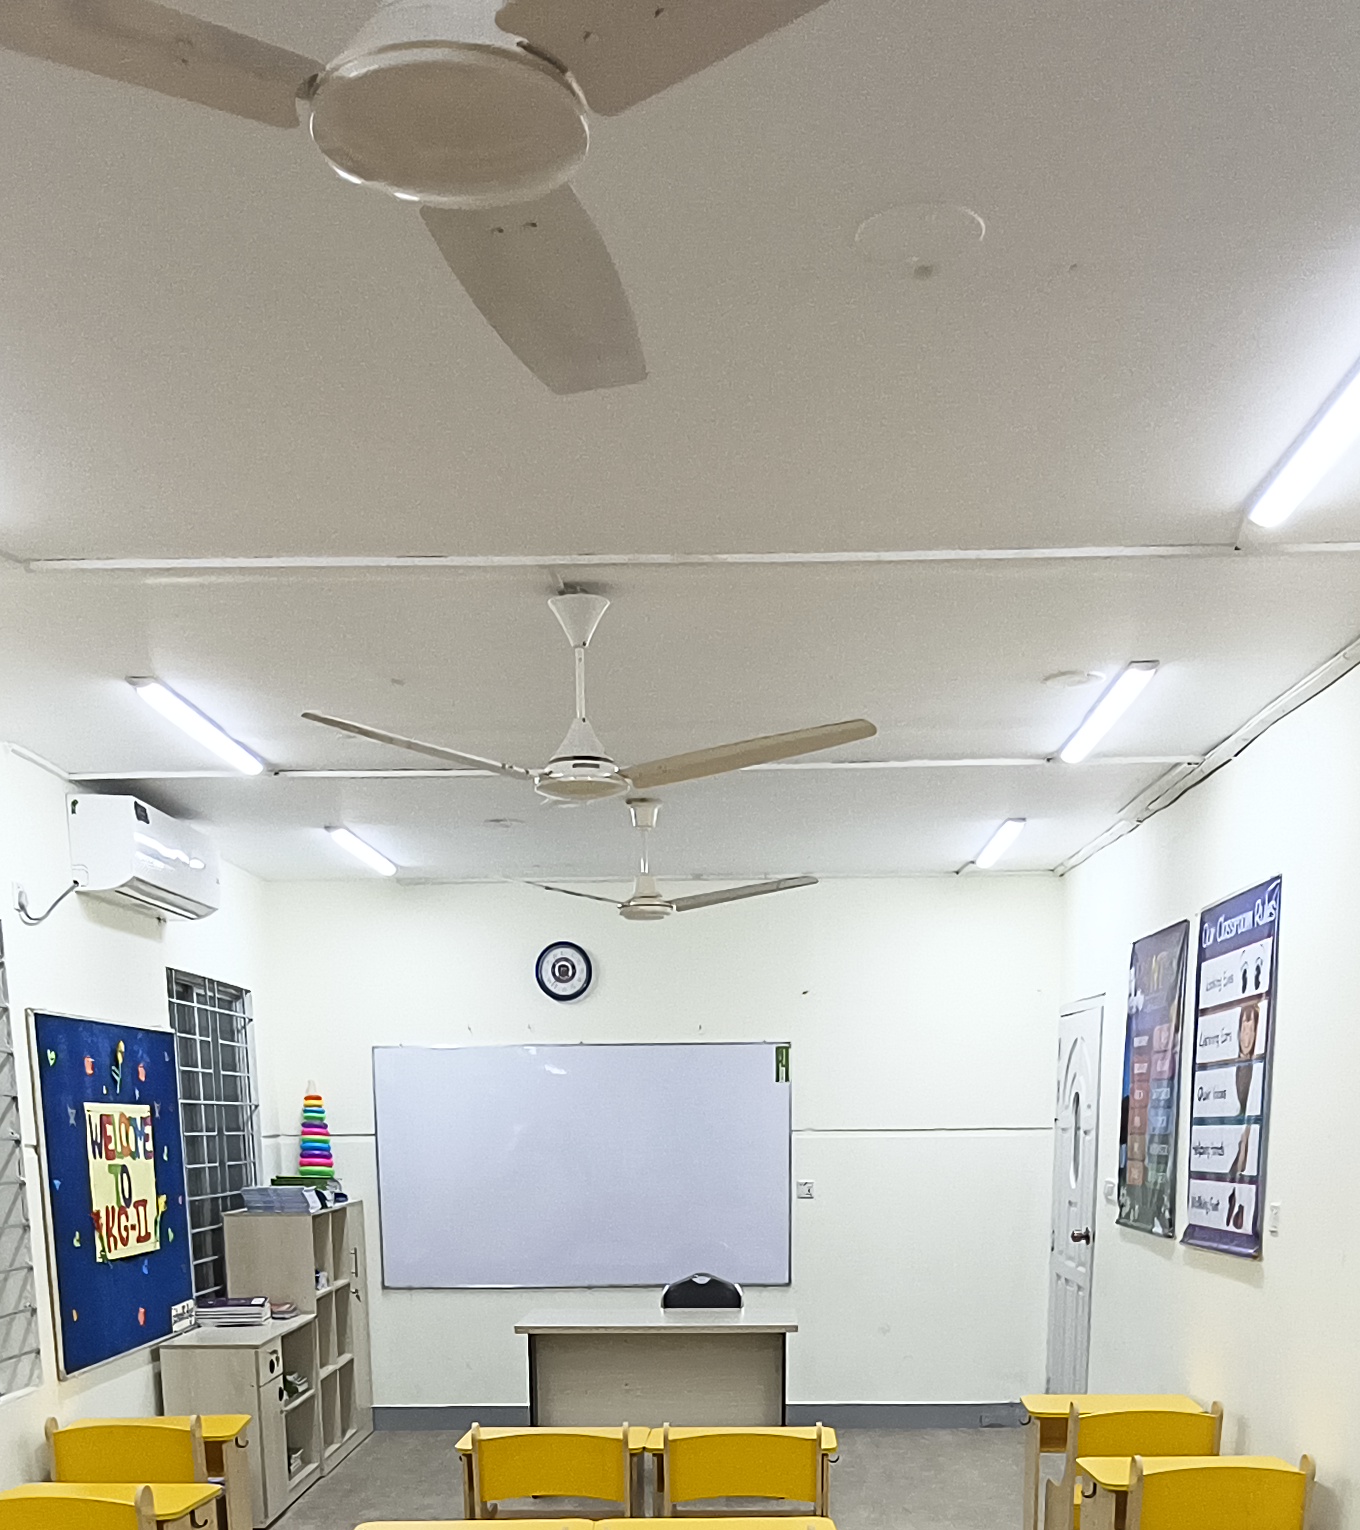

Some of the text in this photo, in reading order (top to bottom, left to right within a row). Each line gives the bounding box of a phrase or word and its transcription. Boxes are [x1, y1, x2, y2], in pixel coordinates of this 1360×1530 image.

[1202, 922, 1216, 949] Our
[1254, 894, 1277, 928] Rules
[88, 1111, 154, 1160] WELCOME
[107, 1163, 132, 1209] TO
[105, 1198, 152, 1253] KG-II
